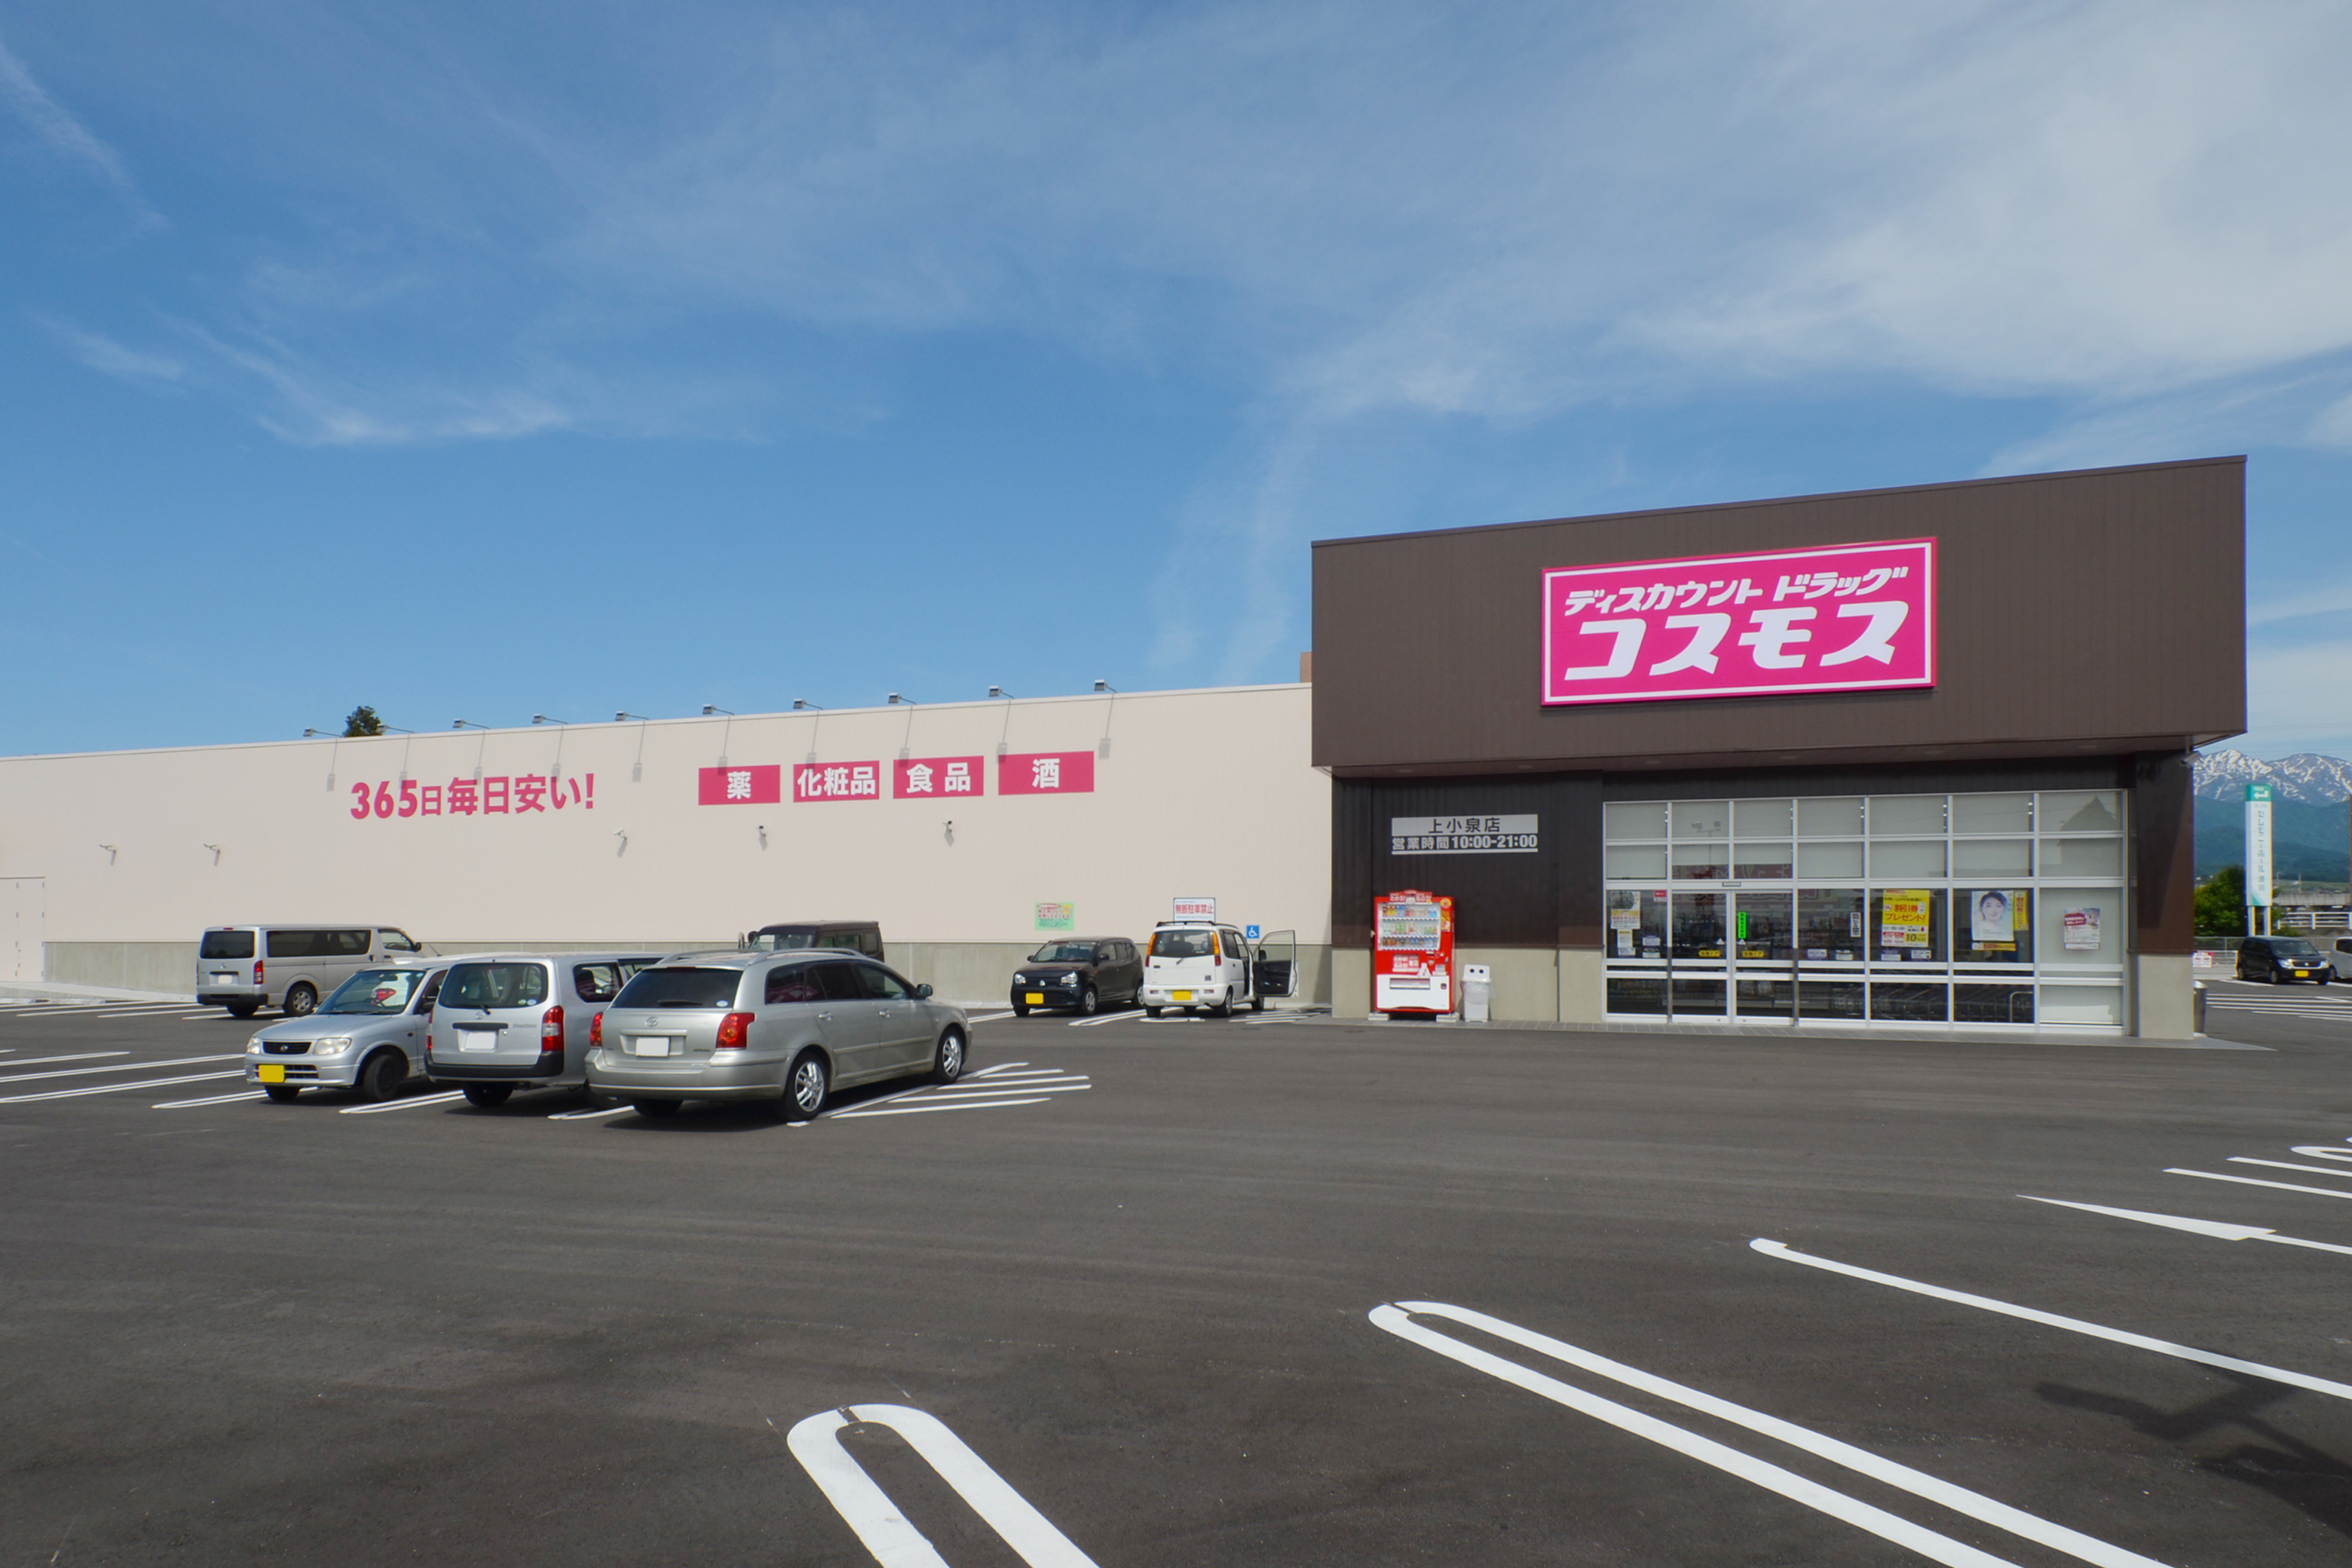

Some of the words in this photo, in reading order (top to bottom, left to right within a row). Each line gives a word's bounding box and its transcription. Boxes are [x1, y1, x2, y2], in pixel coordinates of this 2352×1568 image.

[1565, 579, 1763, 616] ディスカウント
[1773, 566, 1909, 602] ドラッグ
[1564, 601, 1909, 681] コスモス
[727, 770, 752, 800] 薬
[797, 766, 876, 798] 化粧品
[906, 761, 971, 794] 食品
[1031, 758, 1061, 789] 酒
[350, 773, 595, 819] 365日毎日安い!
[1428, 817, 1500, 834] 上小泉店
[1175, 904, 1213, 914] 無断駐車禁止
